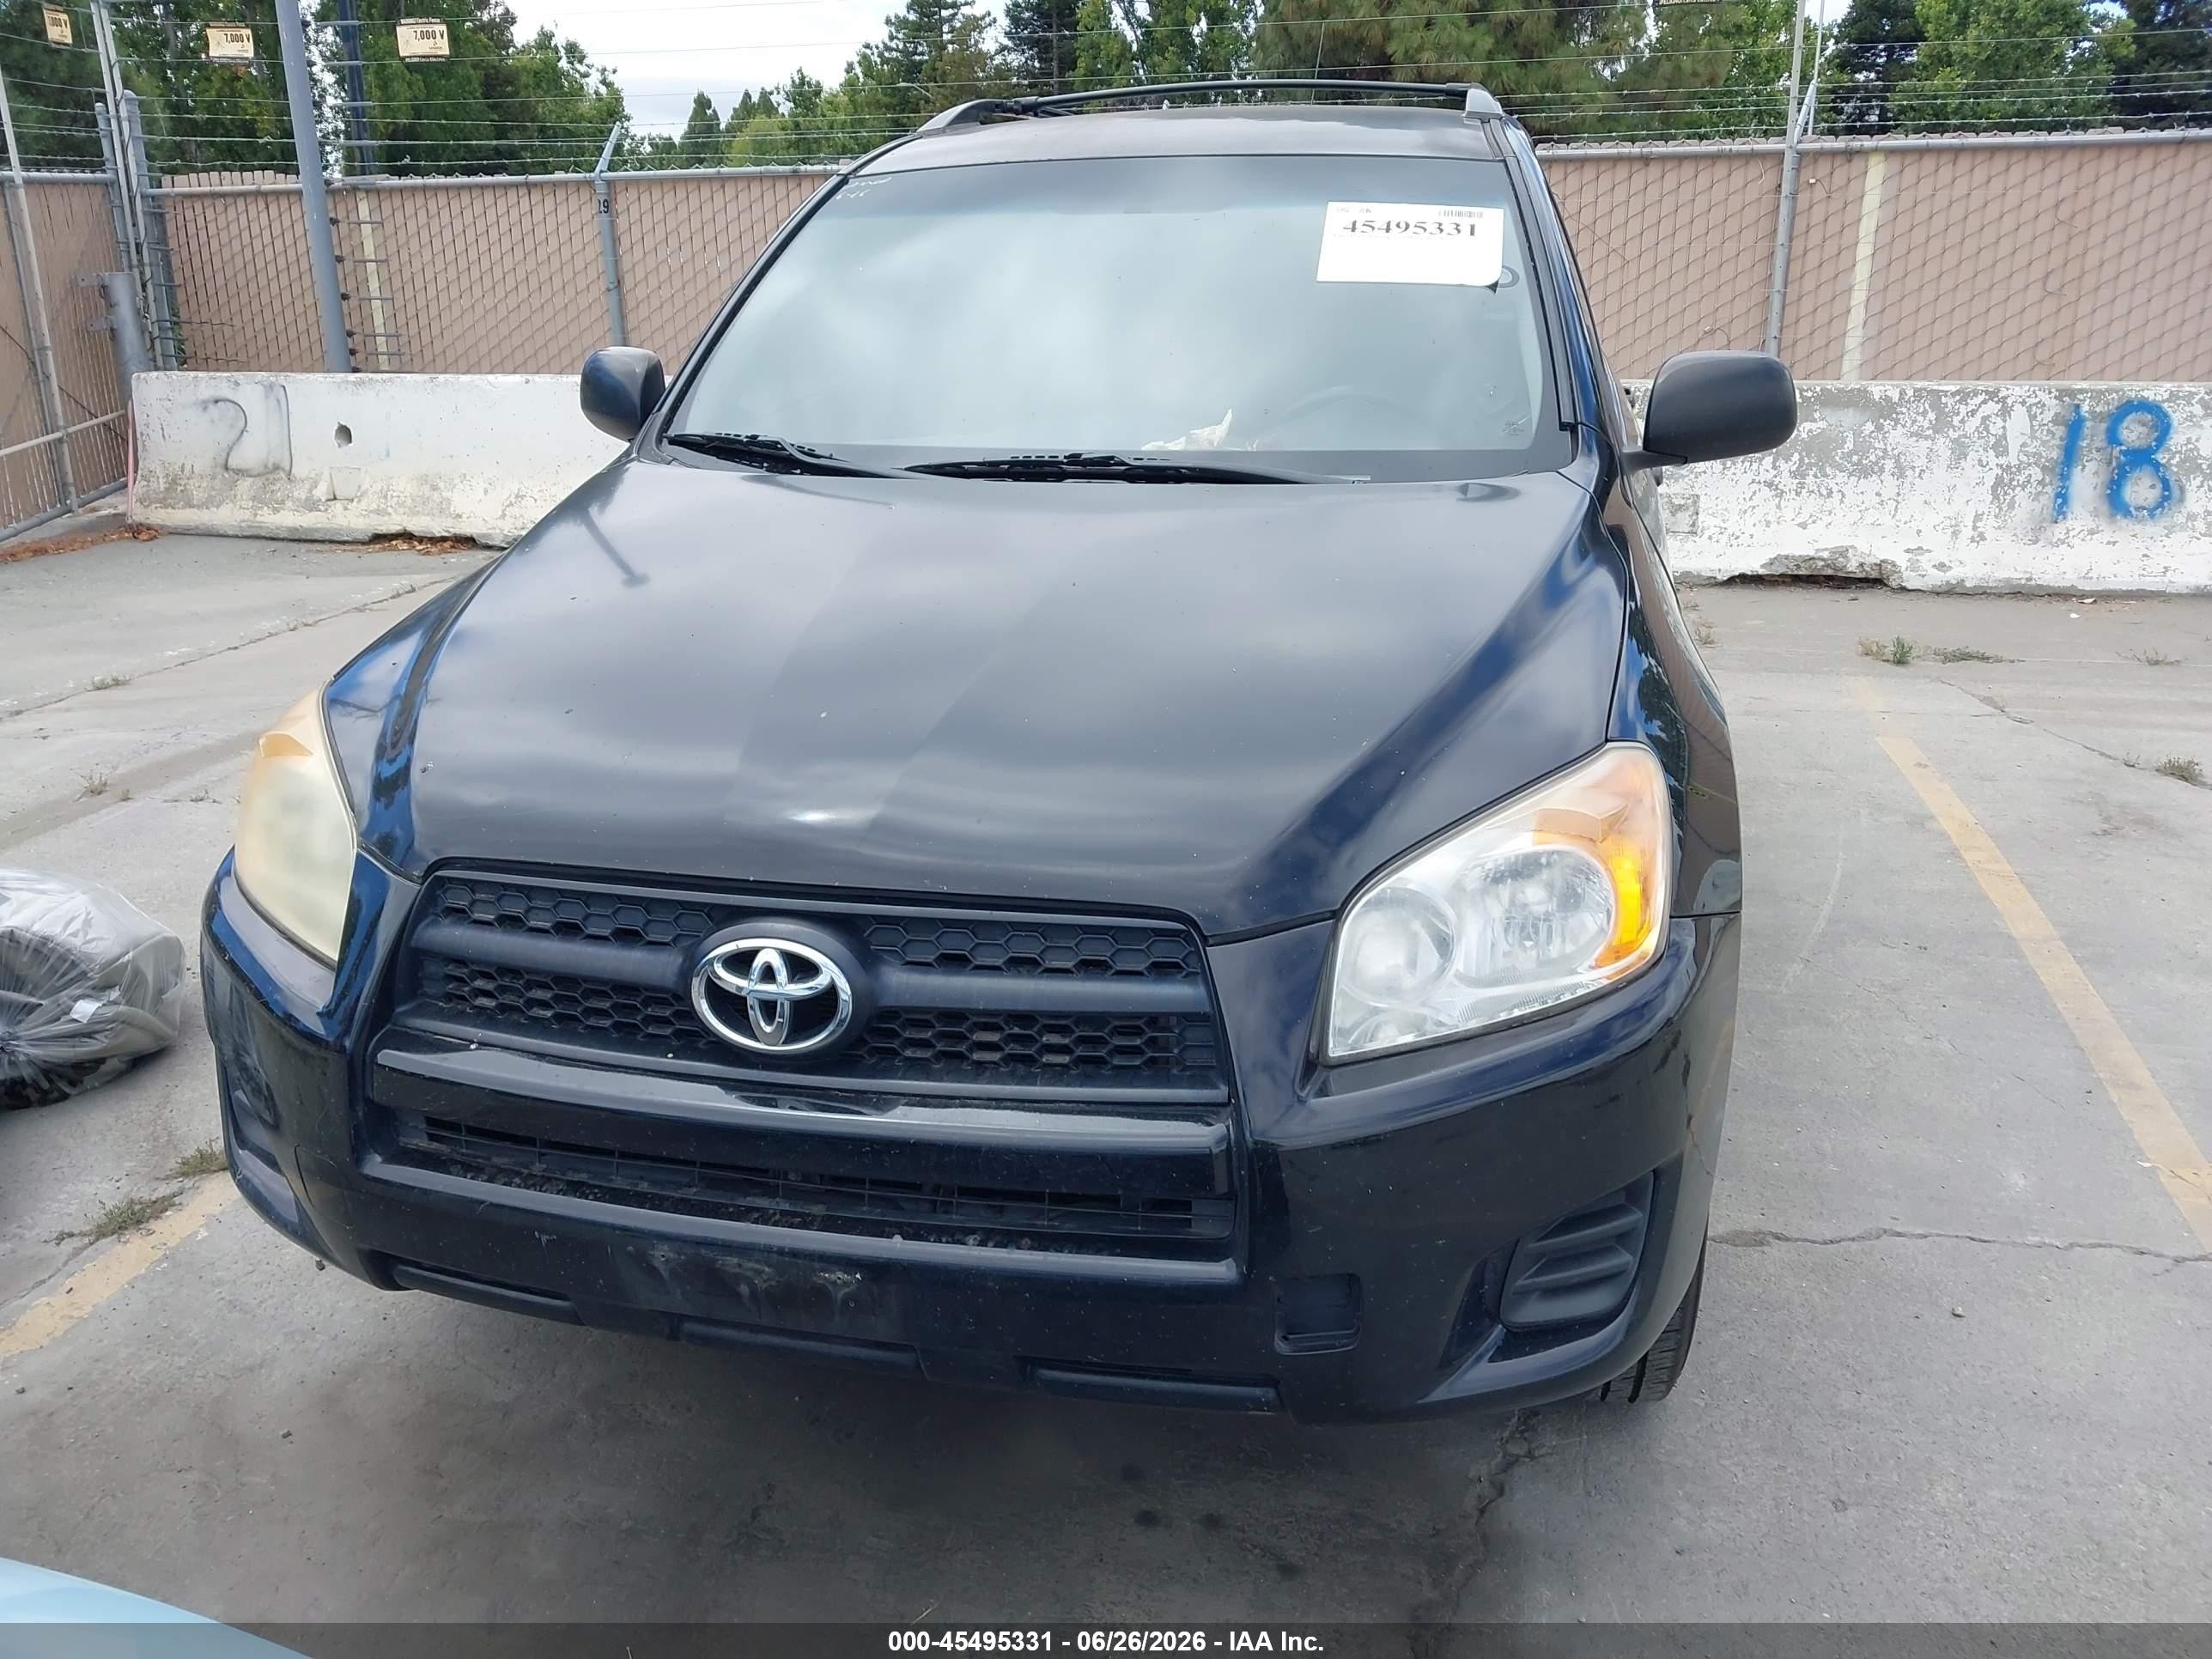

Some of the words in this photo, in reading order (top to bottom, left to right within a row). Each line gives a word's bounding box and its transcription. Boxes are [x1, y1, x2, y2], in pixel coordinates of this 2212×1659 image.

[223, 33, 245, 44] 7,000
[245, 33, 251, 44] V
[412, 29, 437, 41] 7,000
[438, 29, 445, 40] V
[597, 198, 610, 214] 19
[1342, 219, 1476, 237] 45495331
[2052, 399, 2174, 523] 18
